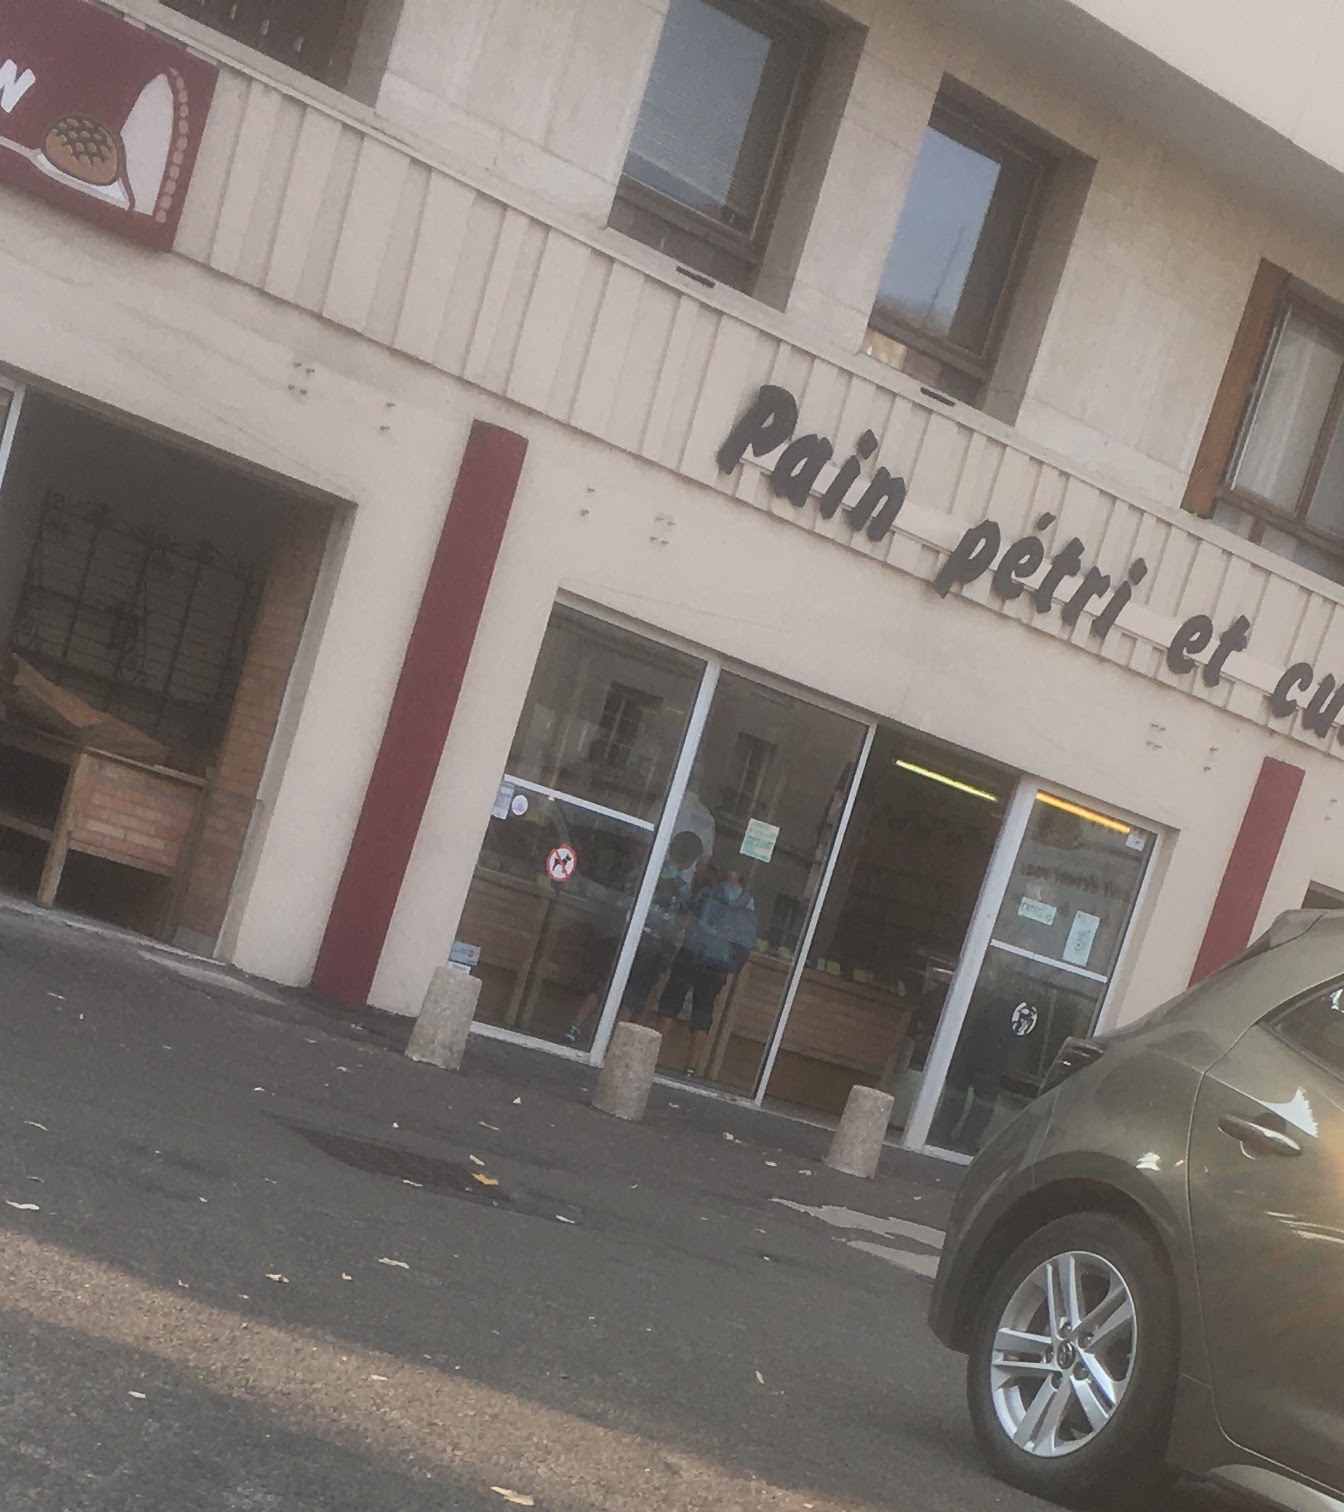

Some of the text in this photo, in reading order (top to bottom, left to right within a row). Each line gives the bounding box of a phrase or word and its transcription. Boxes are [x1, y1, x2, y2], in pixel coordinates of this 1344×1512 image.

[715, 384, 907, 542] Pain
[933, 511, 1149, 639] pétri
[1165, 613, 1251, 687] et
